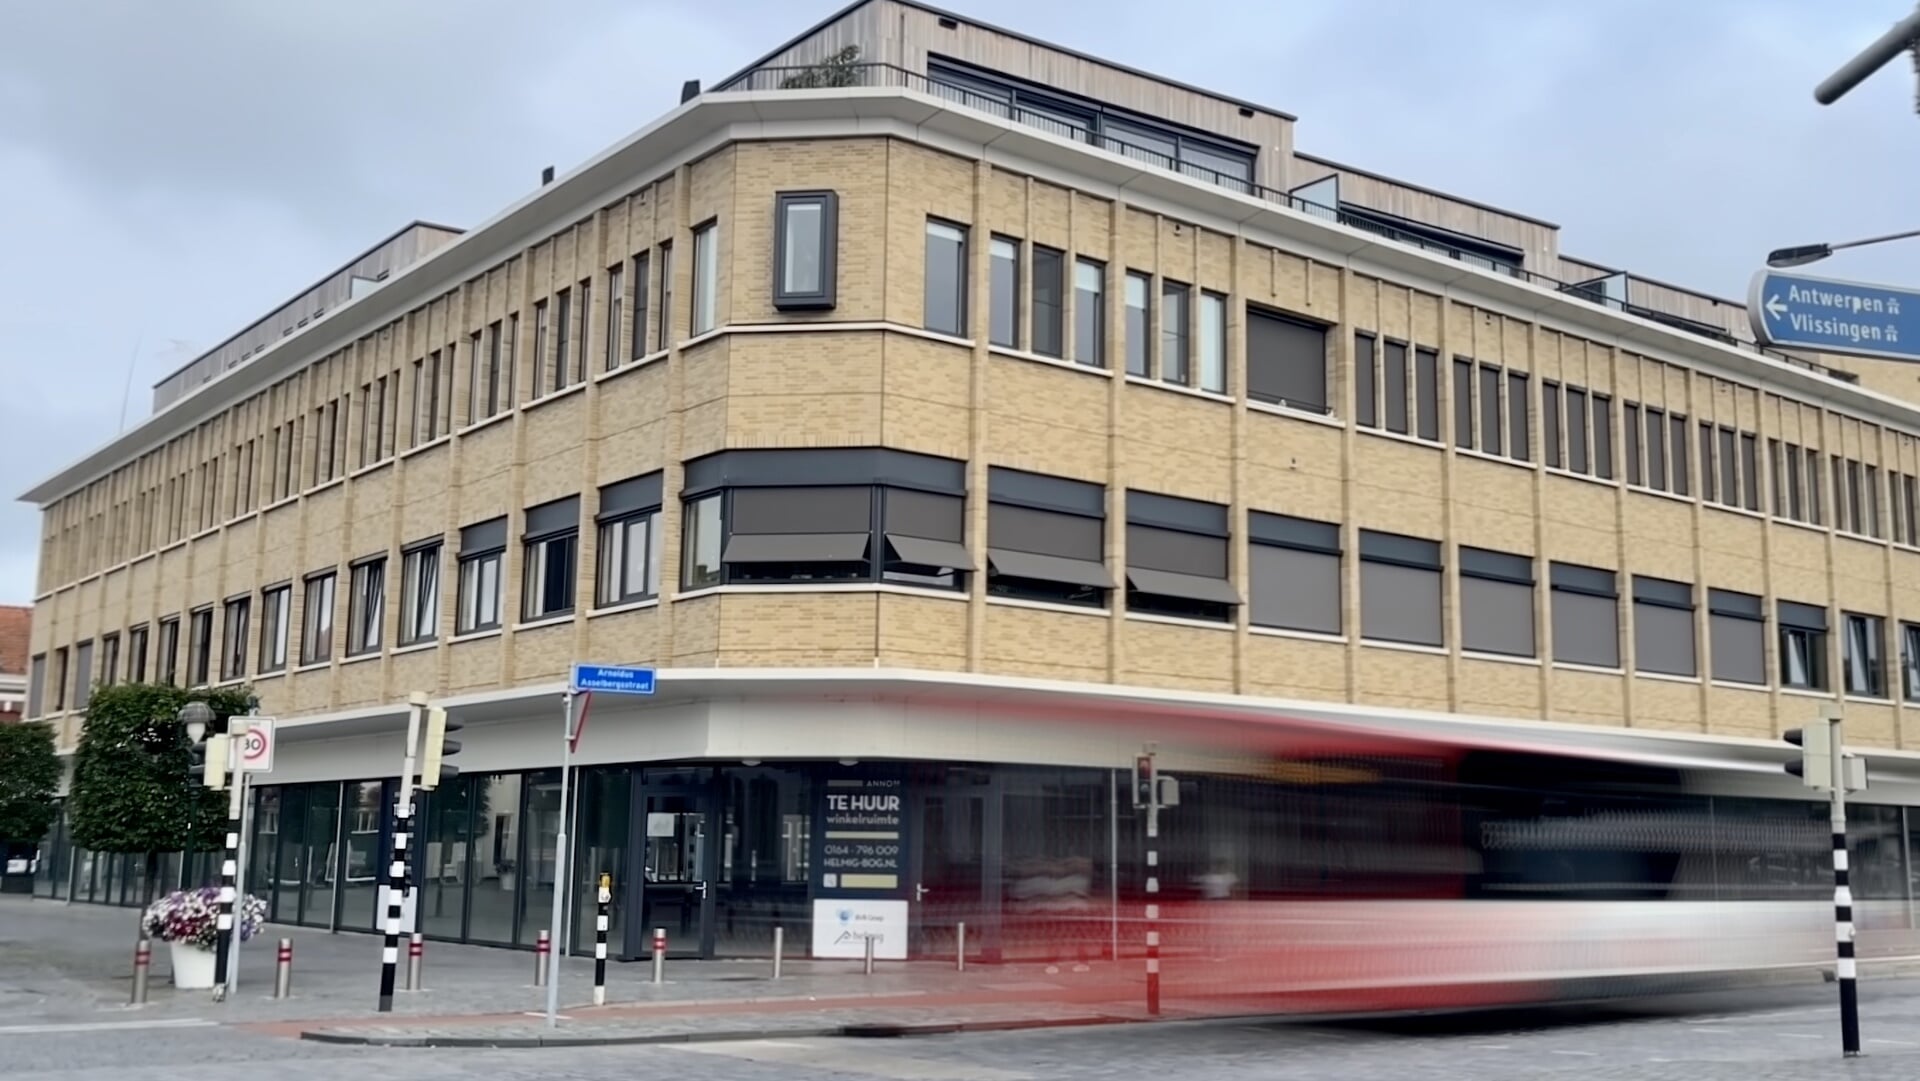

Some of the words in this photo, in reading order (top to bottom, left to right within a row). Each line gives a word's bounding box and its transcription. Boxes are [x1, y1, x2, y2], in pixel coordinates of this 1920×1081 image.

[1789, 284, 1883, 314] Antwerpen
[1790, 313, 1881, 342] Vlissingen
[598, 669, 634, 678] Arnoldus
[827, 795, 848, 810] TE
[850, 795, 900, 811] HUUR
[826, 813, 899, 825] winkelruimte
[824, 845, 849, 855] 0164
[856, 845, 874, 855] 796
[876, 845, 899, 855] 009
[823, 858, 898, 868] HELMIG-BOG.NL
